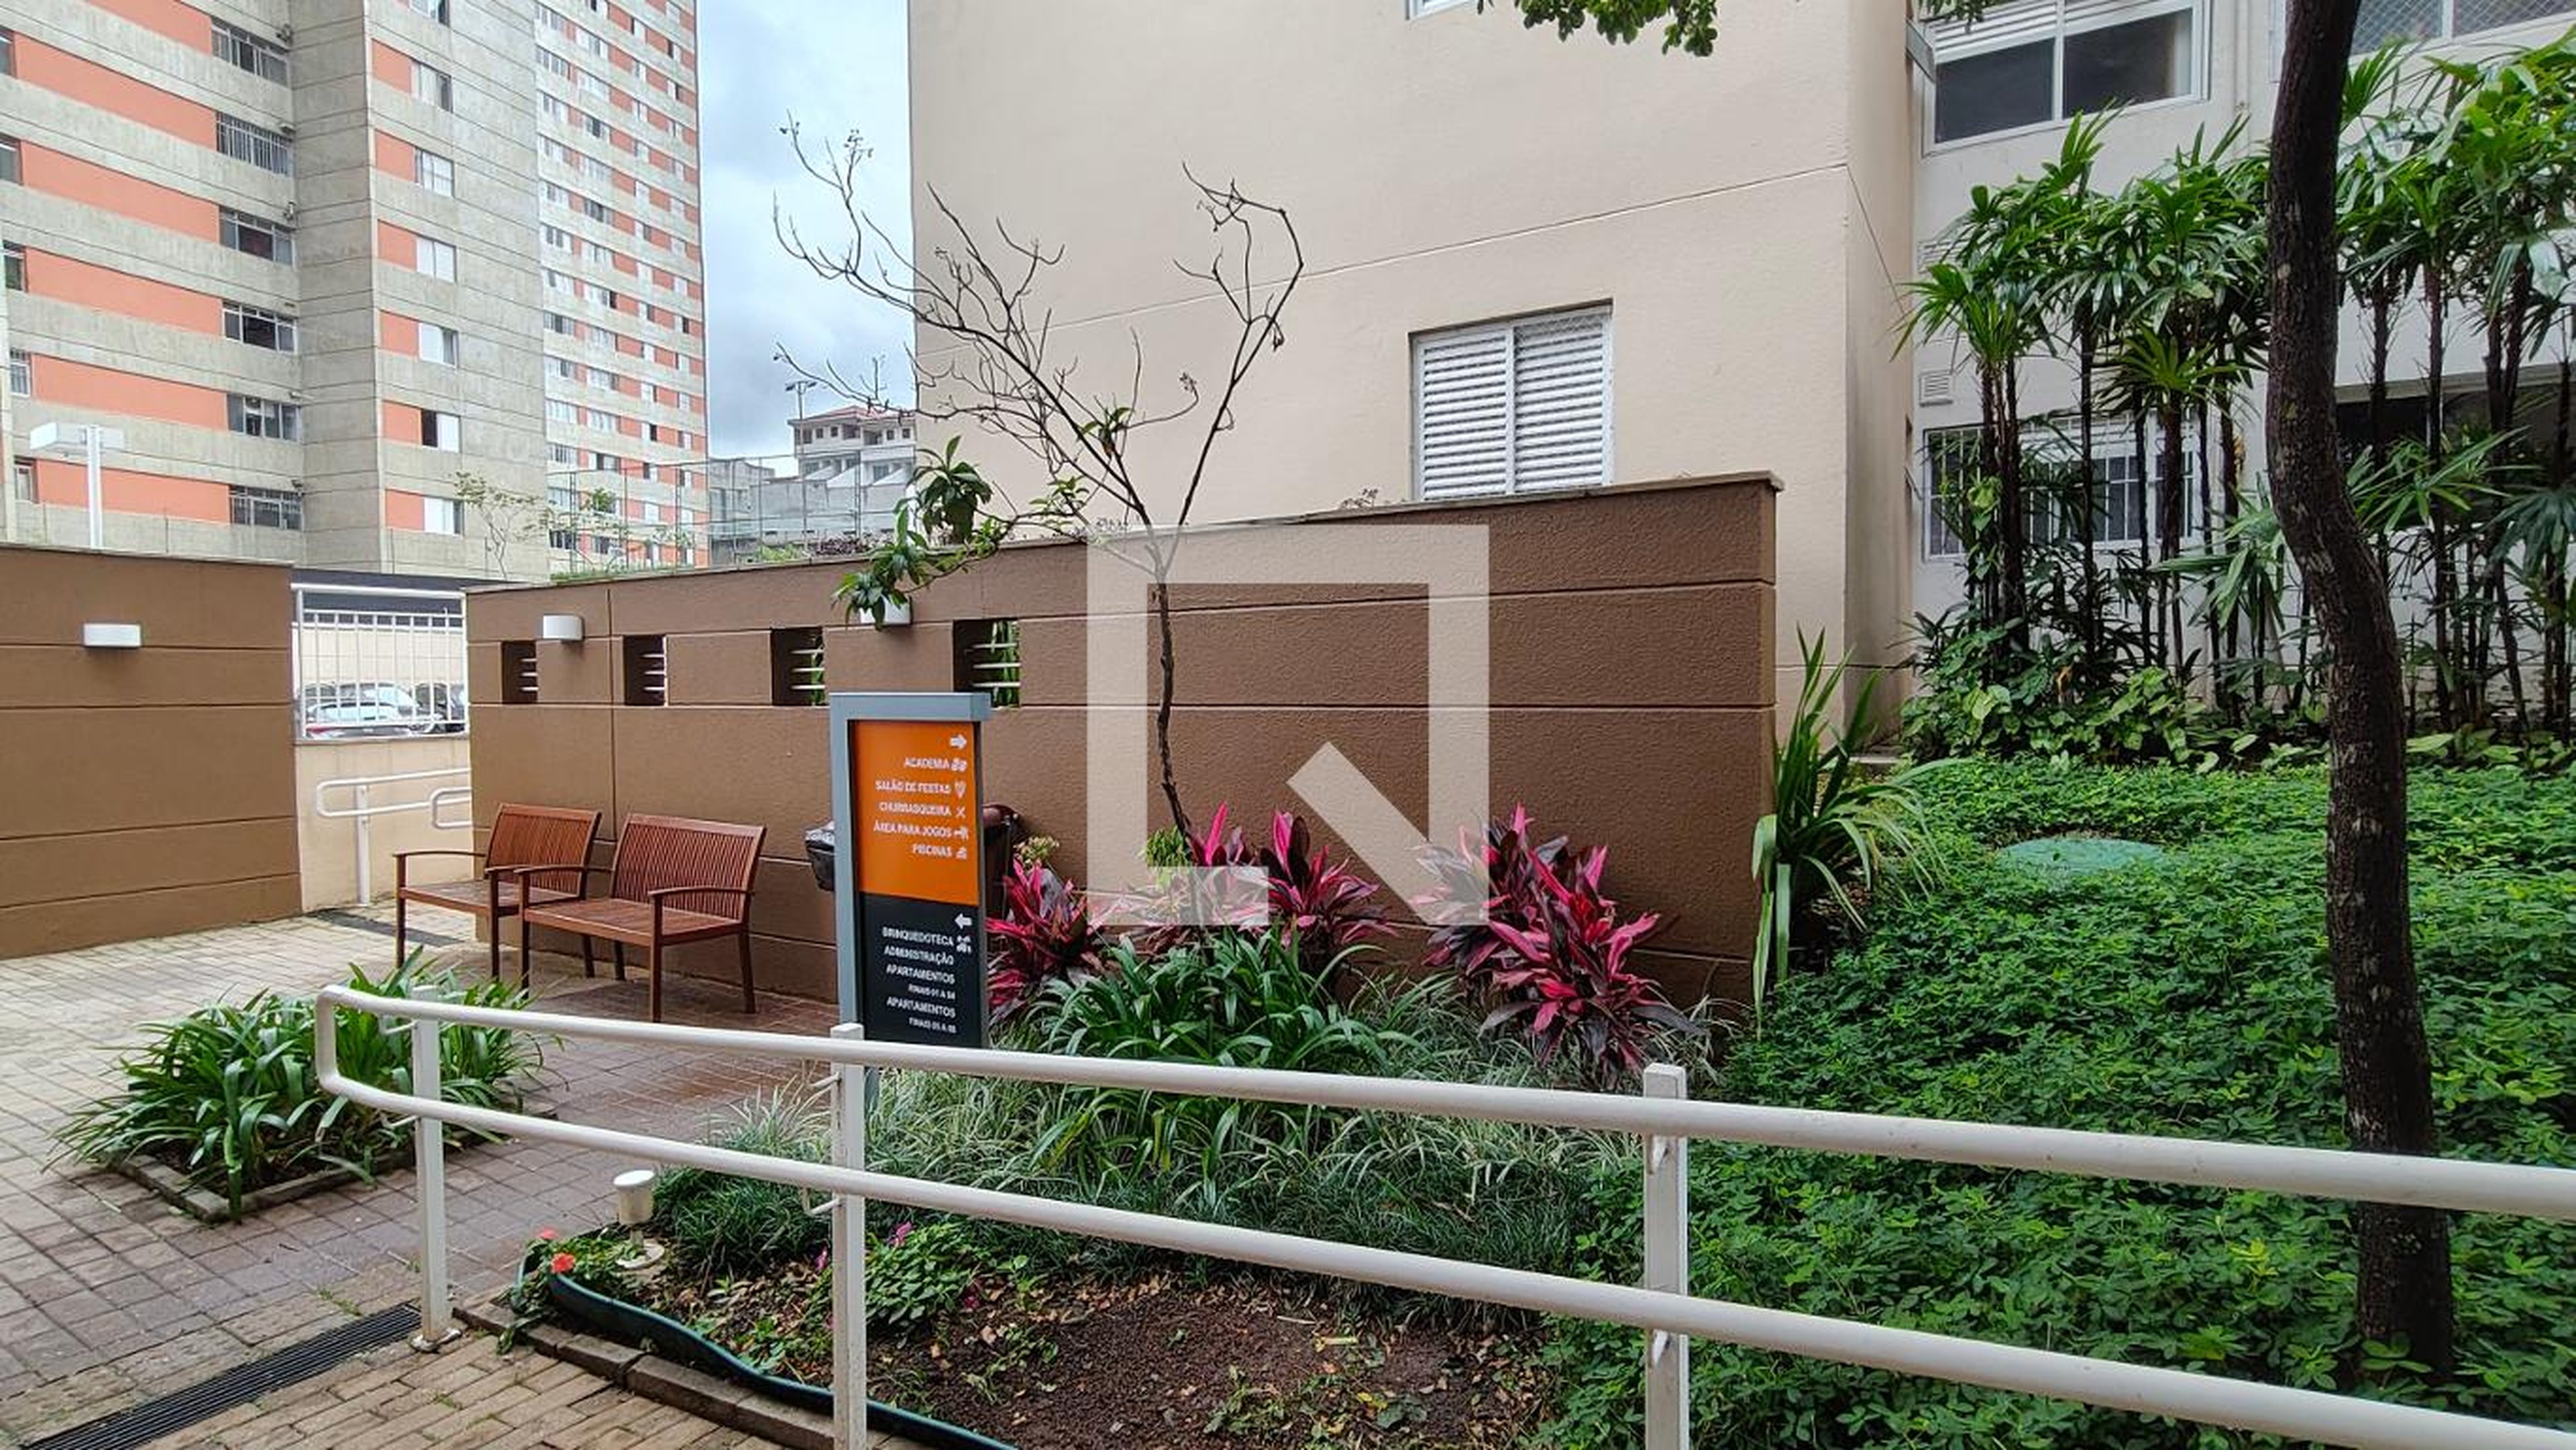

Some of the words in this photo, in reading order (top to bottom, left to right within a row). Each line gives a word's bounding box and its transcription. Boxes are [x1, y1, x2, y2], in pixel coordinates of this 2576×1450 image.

[904, 758, 950, 770] ACADEMIA
[875, 779, 904, 792] SALÃO
[905, 782, 918, 792] DE
[918, 782, 951, 794] FESTAS
[879, 802, 951, 816] CHURRASQUEIRA
[873, 819, 898, 833] ÁREA
[898, 823, 921, 835] PARA
[922, 825, 952, 838] JOGOS
[912, 843, 952, 858] PISCINAS
[881, 926, 953, 947] BRINQUEDOTECA
[884, 945, 954, 965] ADMINISTRAÇÃO
[886, 964, 955, 984] APARTAMENTOS
[886, 996, 956, 1019] APARTAMENTOS
